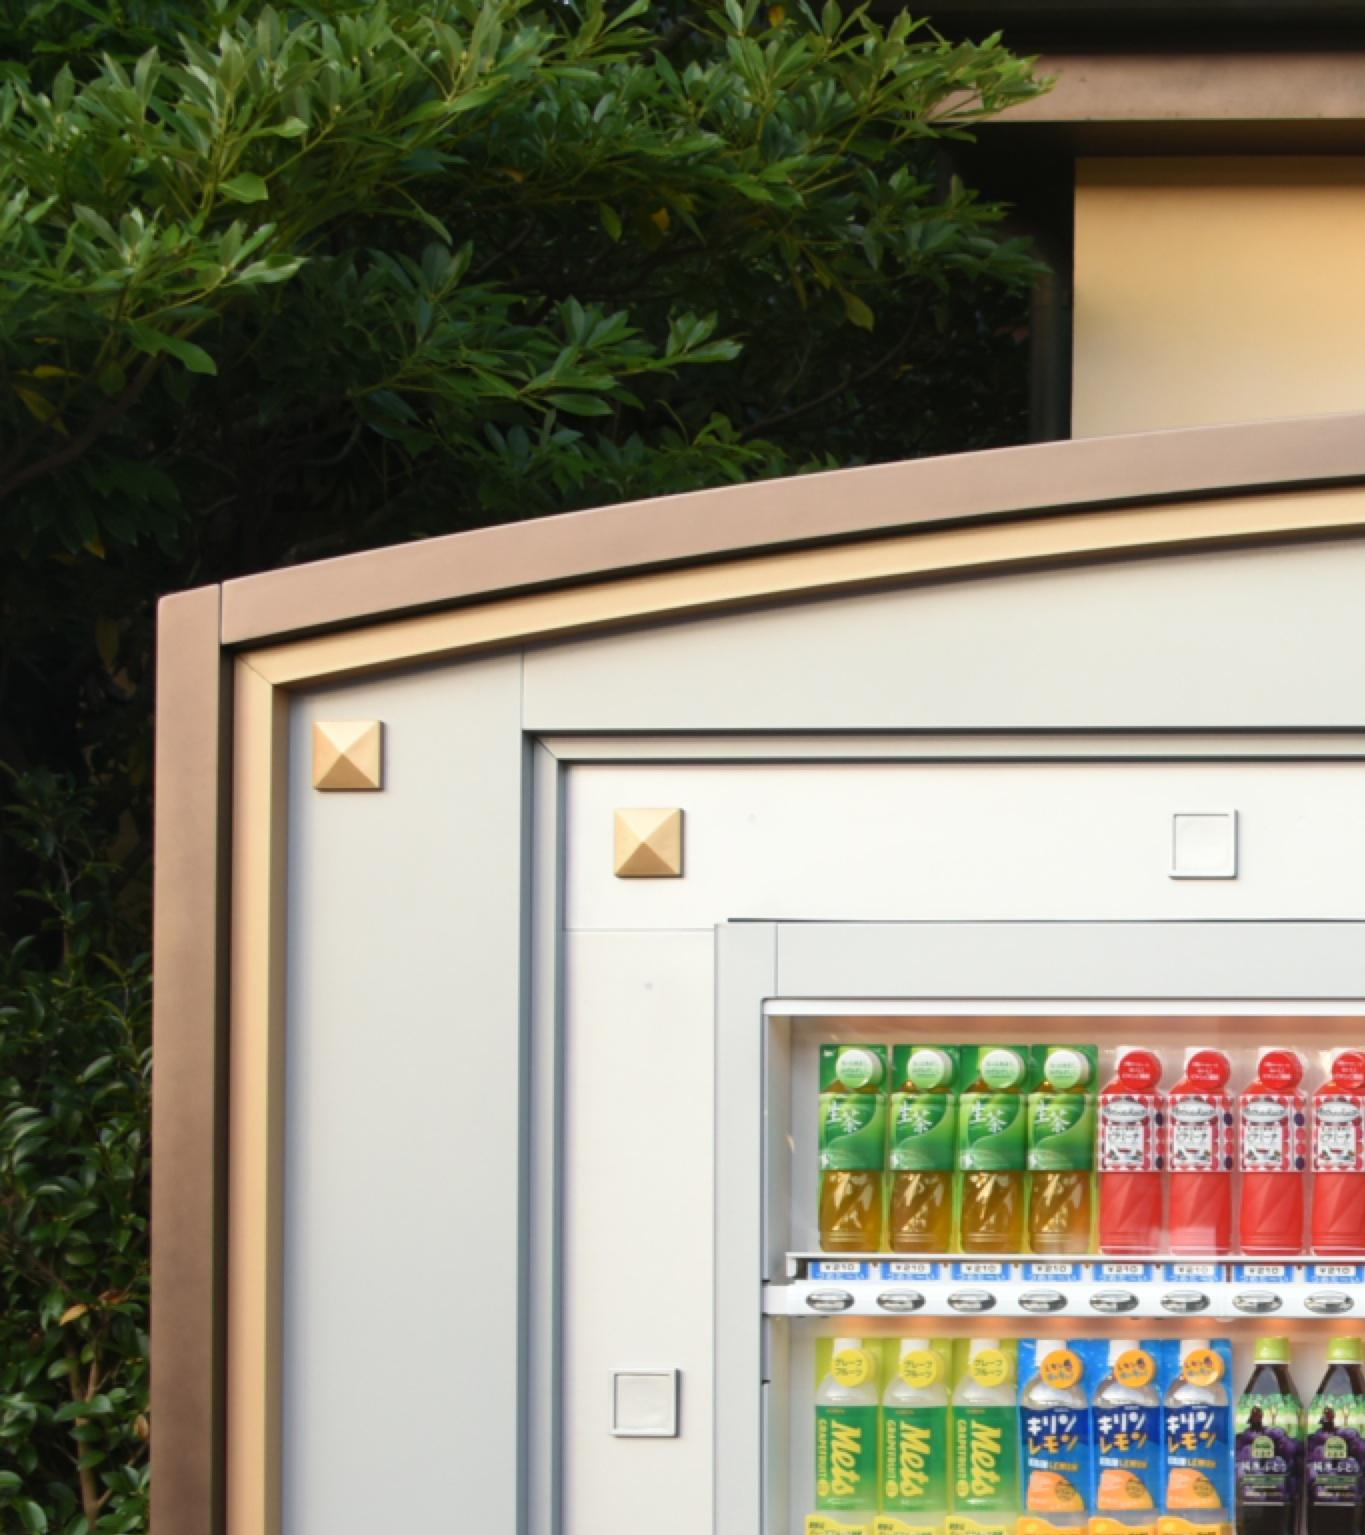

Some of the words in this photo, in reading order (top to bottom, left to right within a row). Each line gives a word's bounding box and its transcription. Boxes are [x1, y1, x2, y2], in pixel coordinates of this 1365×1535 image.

[1027, 1414, 1077, 1435] キリン
[1098, 1412, 1147, 1435] キリン
[1167, 1412, 1216, 1434] キリン
[1029, 1434, 1078, 1454] レモン
[1100, 1433, 1148, 1454] レモン
[1168, 1432, 1216, 1454] レモン
[831, 1419, 863, 1496] Mets
[900, 1421, 932, 1498] Mets
[970, 1420, 1003, 1498] Mets
